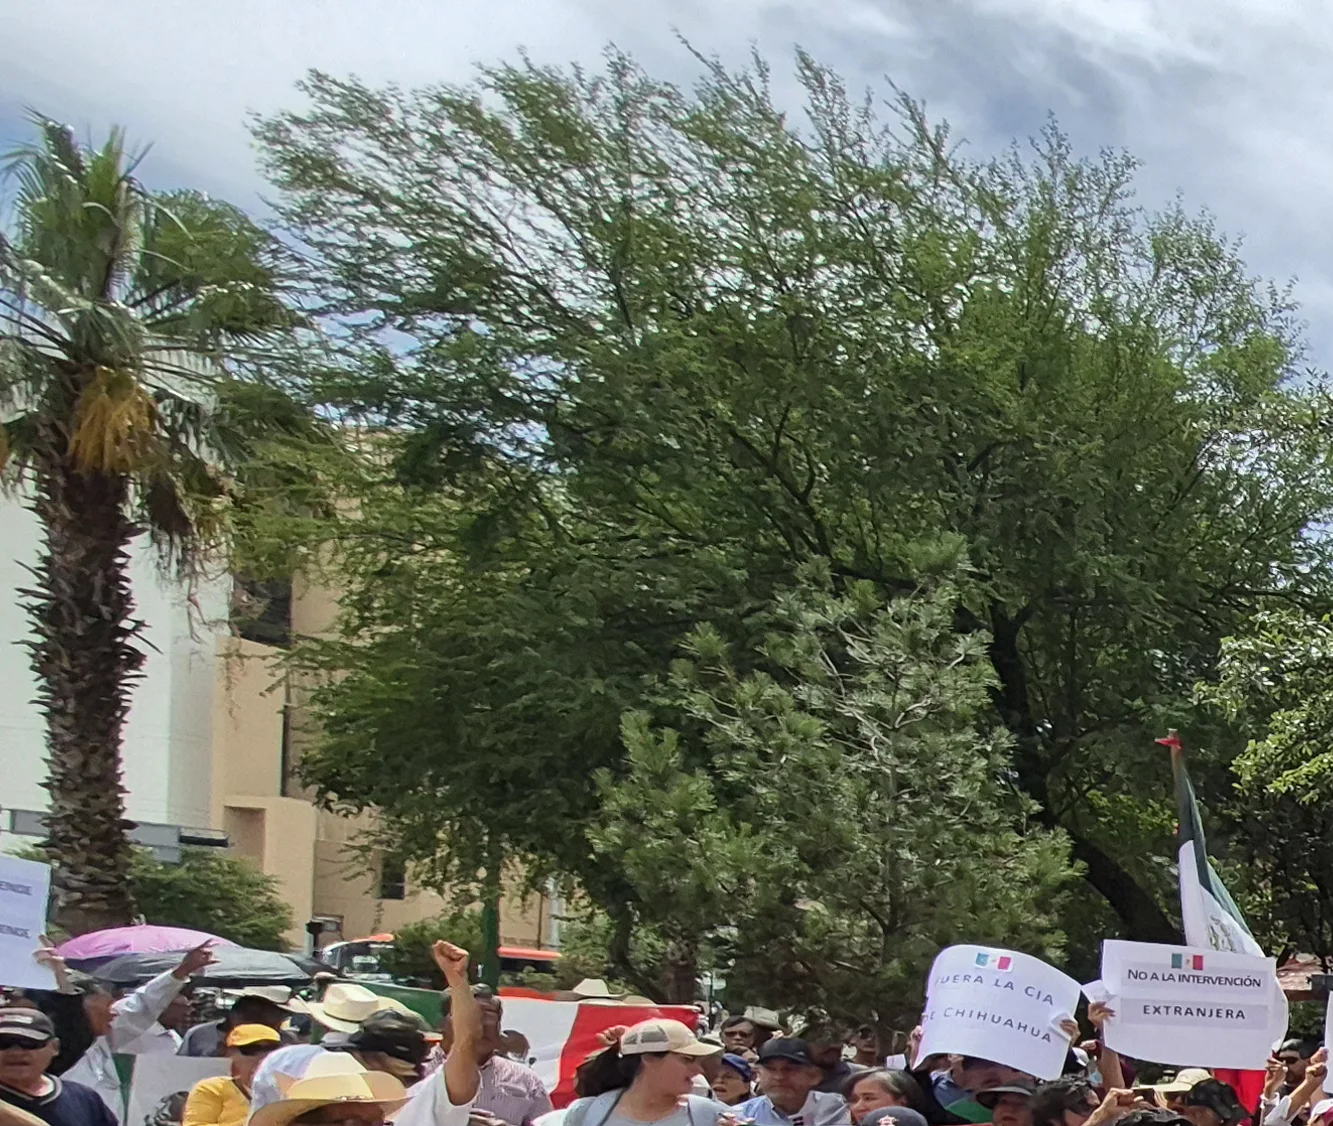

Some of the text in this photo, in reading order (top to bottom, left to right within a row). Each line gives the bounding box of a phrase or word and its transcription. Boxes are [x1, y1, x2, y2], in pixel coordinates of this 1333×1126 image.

[1149, 972, 1159, 981] A
[1161, 972, 1176, 983] LA
[1178, 973, 1262, 988] INTERVENCIÓN
[993, 977, 1015, 992] LA
[1024, 985, 1054, 1006] CIA
[1143, 1004, 1246, 1020] EXTRANJERA
[943, 1006, 1052, 1044] CHIHUAHUA
